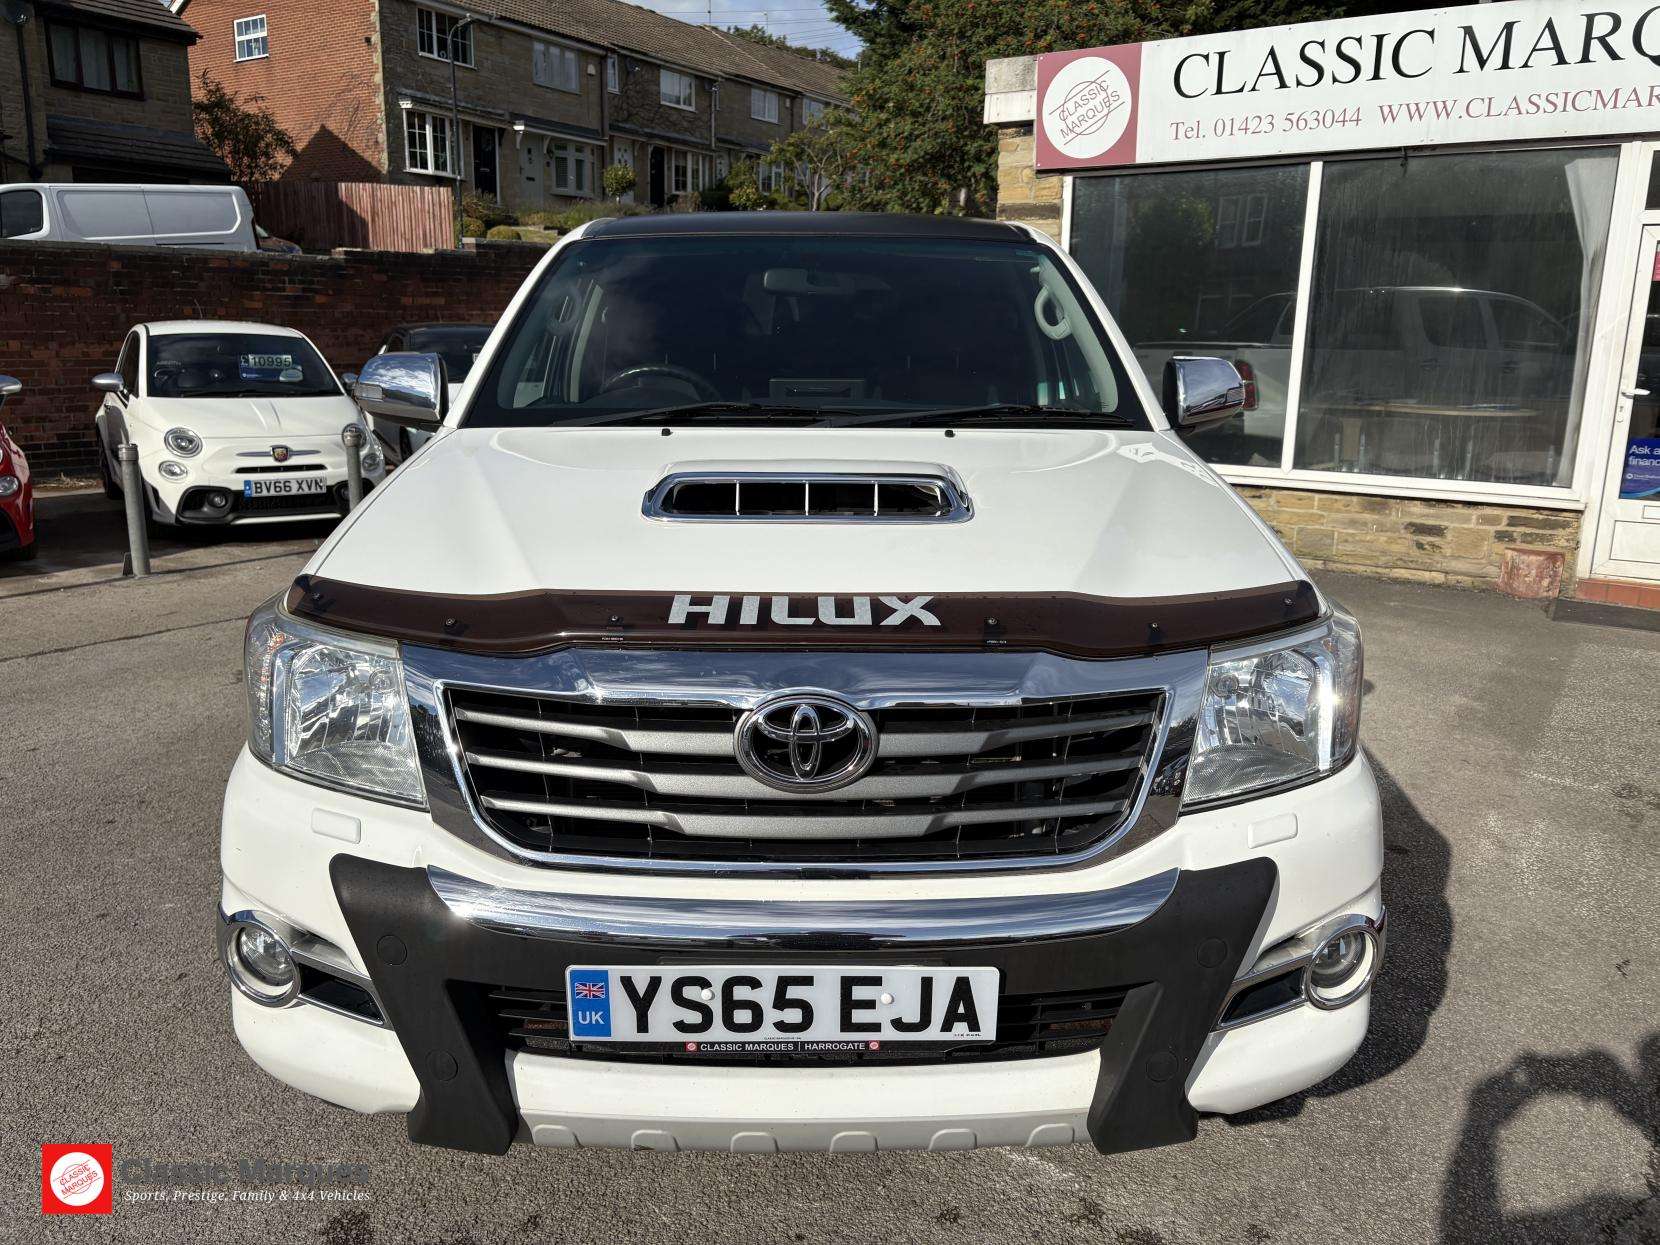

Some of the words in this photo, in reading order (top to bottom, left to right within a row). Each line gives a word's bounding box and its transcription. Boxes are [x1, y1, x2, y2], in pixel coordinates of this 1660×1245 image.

[1173, 28, 1436, 99] CLASSIC
[1059, 80, 1109, 121] CLASSIC
[1060, 90, 1120, 138] MARQUES
[1170, 121, 1206, 141] Tel.
[1213, 114, 1275, 137] 01423
[1282, 106, 1362, 132] 563044
[1629, 445, 1651, 454] Ask
[254, 481, 292, 494] BV66
[667, 594, 942, 626] HILUX
[578, 1011, 605, 1025] UK
[619, 975, 815, 1034] YS65
[839, 975, 981, 1033] EJA
[700, 1043, 742, 1051] CLASSIC
[745, 1043, 794, 1051] MARQUES
[804, 1042, 866, 1050] HARROGATE
